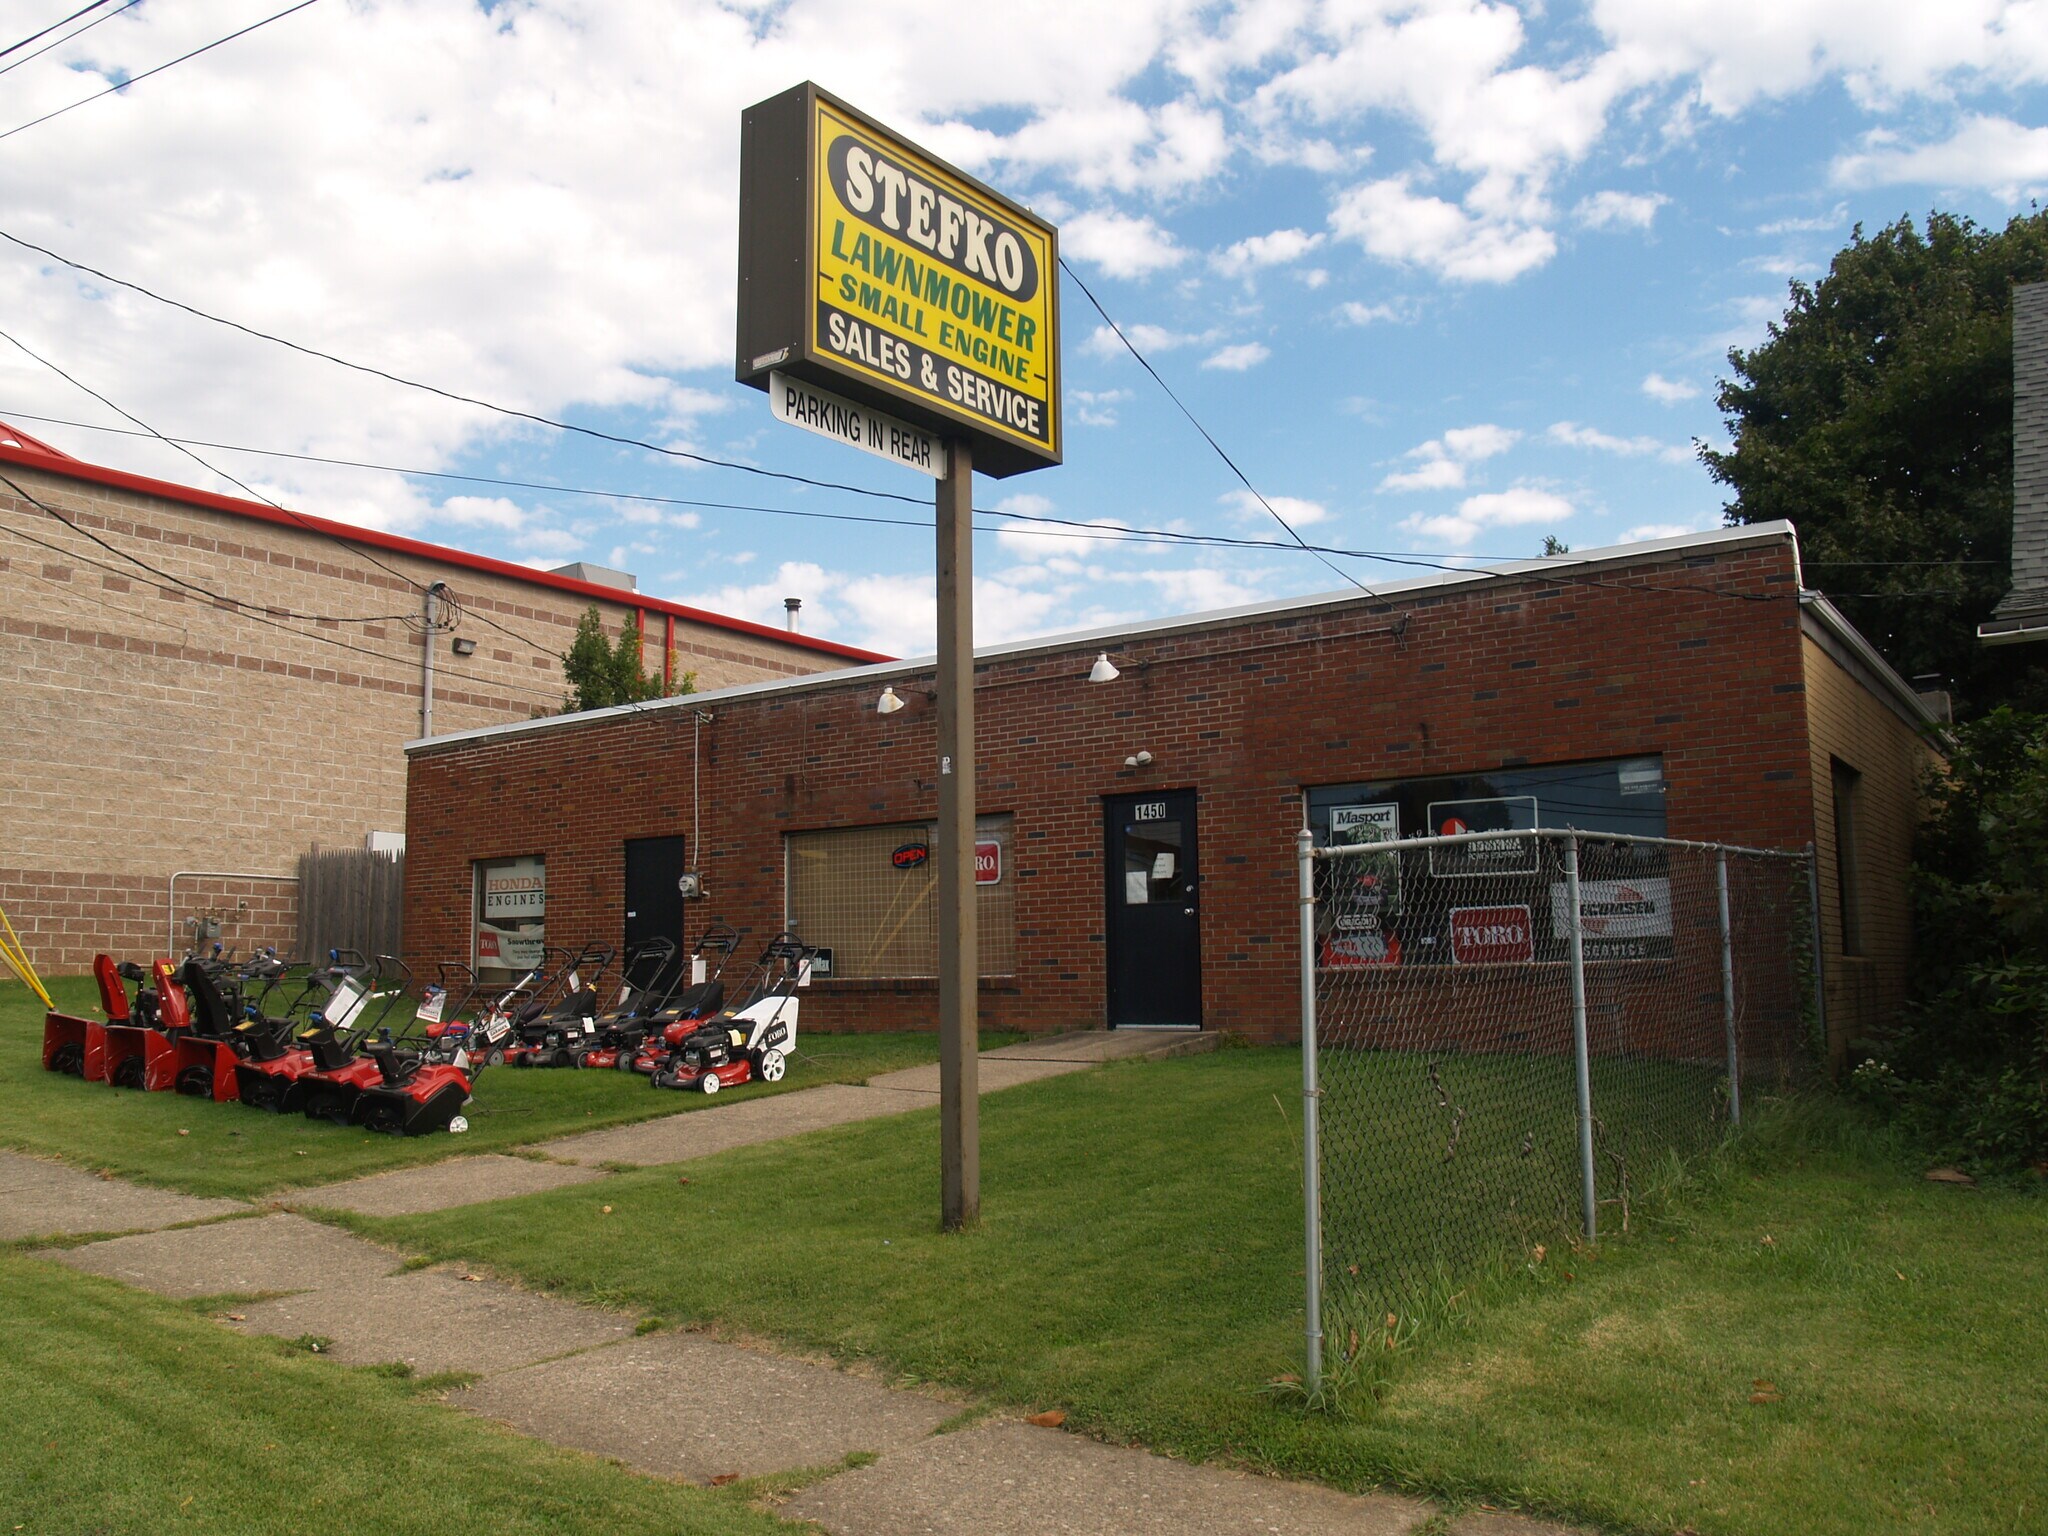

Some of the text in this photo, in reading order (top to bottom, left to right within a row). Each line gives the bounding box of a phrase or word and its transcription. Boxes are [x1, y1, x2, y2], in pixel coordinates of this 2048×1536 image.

[846, 146, 1024, 292] STEFKO
[831, 218, 1036, 352] LAWNMOWER
[839, 273, 1030, 384] SMALL ENGINE
[829, 313, 1040, 435] SALES & SERVICE
[785, 386, 931, 468] PARKING IN REAR
[1136, 803, 1165, 819] 1450
[1336, 810, 1390, 825] Masport
[894, 847, 926, 864] OPEN
[975, 855, 995, 871] RO
[488, 877, 544, 891] HONDA
[488, 893, 545, 907] ENGINES
[1457, 924, 1524, 946] TORO
